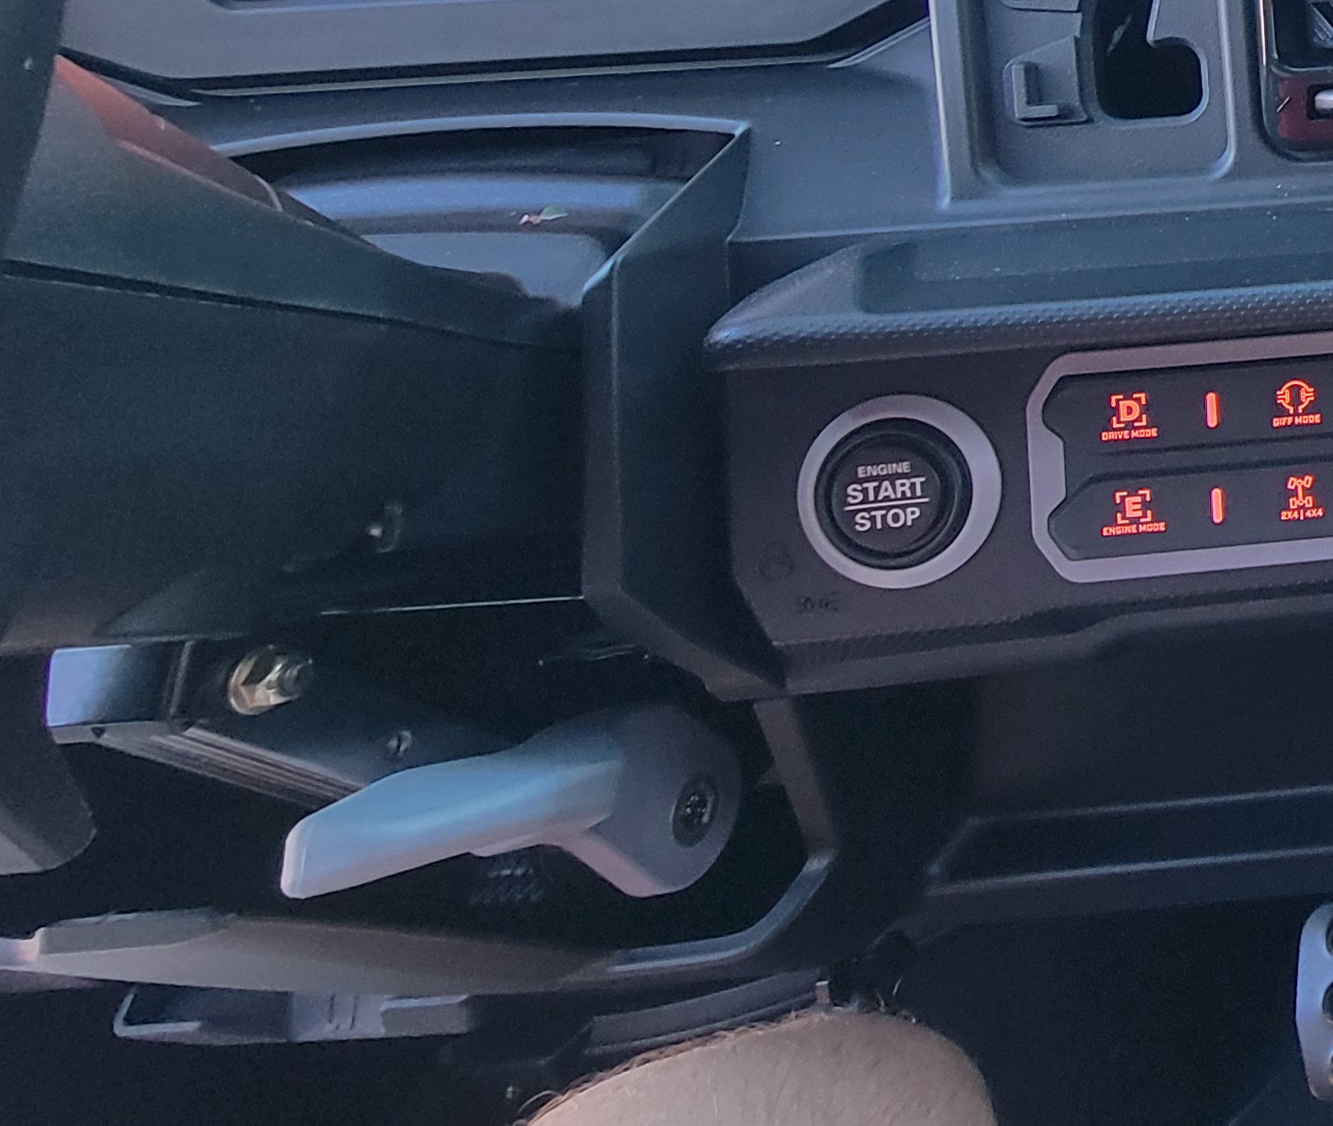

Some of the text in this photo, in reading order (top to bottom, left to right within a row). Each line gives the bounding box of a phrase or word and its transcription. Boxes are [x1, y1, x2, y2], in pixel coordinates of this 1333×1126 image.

[1012, 62, 1059, 119] L
[1119, 399, 1141, 422] D
[1272, 414, 1322, 428] DIFF MODE
[1101, 427, 1158, 442] DRIVE MODE
[857, 461, 911, 478] ENGINE
[846, 477, 926, 504] START
[1124, 495, 1143, 518] E
[854, 506, 921, 532] STOP
[1102, 522, 1166, 537] ENGINE MODE
